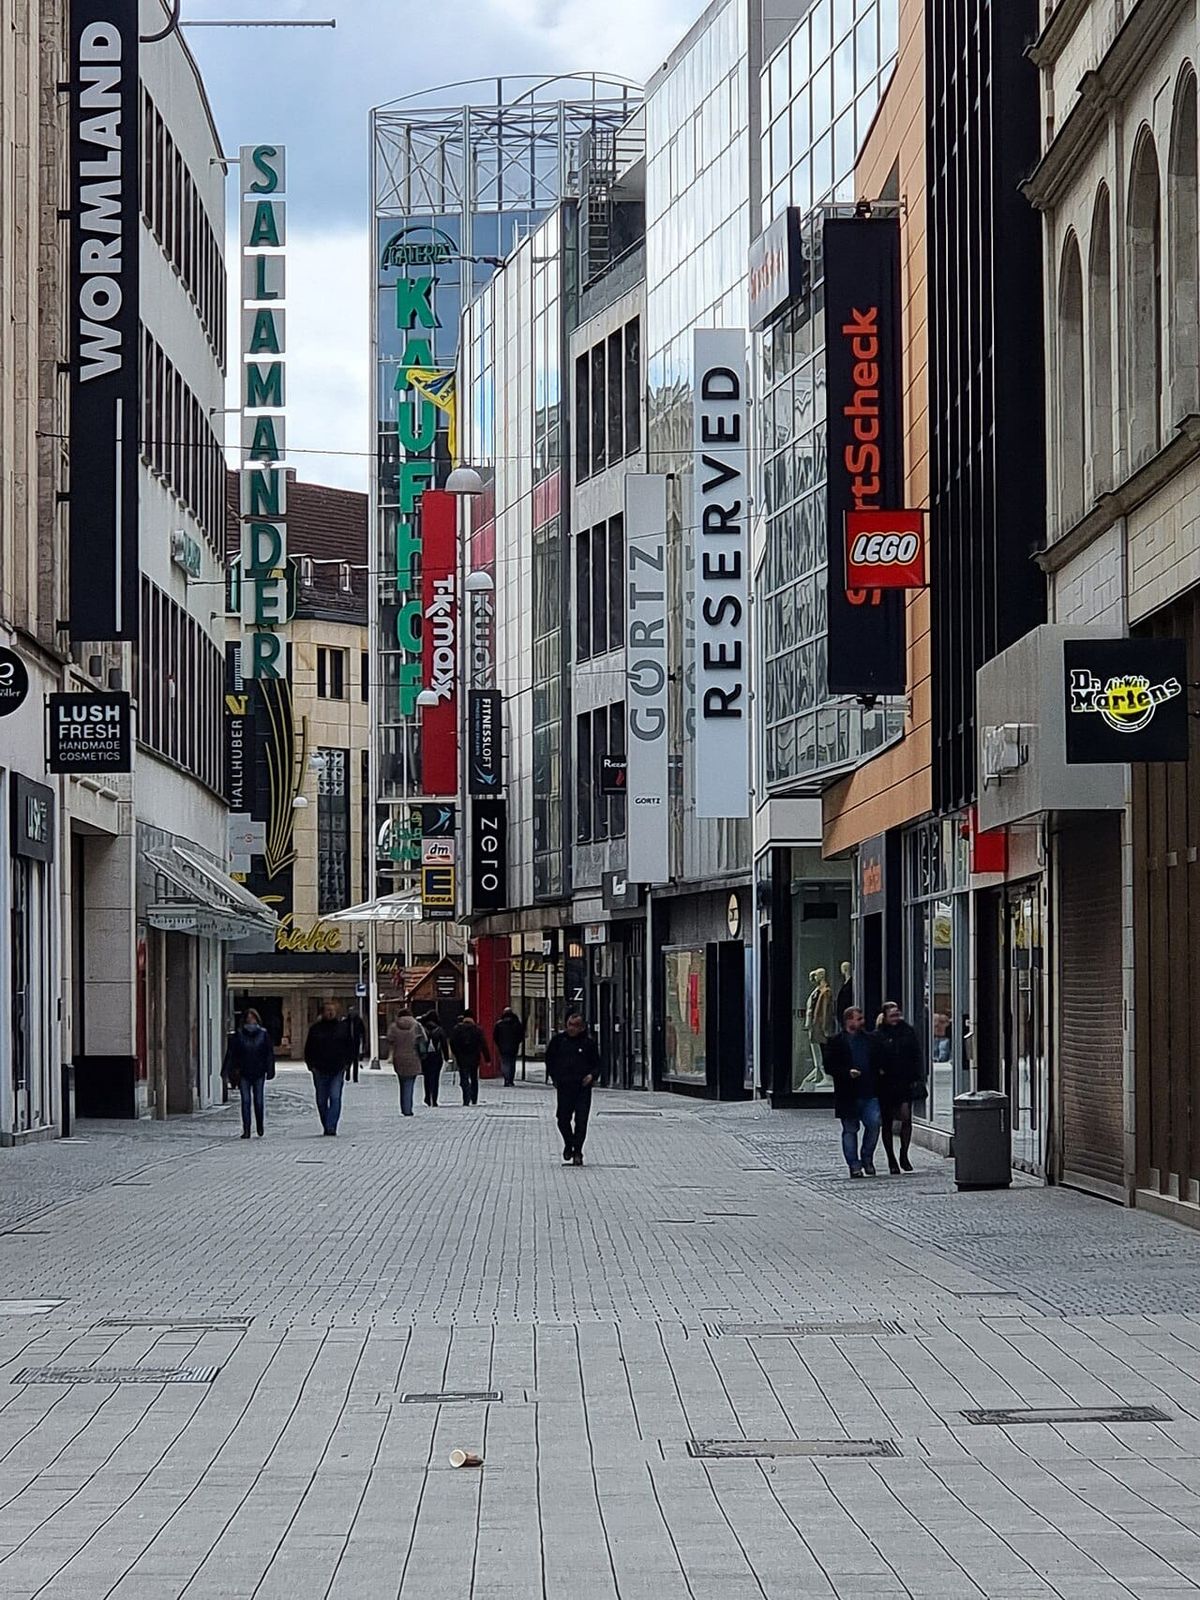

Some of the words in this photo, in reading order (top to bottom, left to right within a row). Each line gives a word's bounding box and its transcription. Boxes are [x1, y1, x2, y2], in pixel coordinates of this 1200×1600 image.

[79, 20, 122, 382] WORMLAND
[247, 145, 283, 679] SALAMANDER
[702, 366, 742, 719] RESERVED
[851, 532, 920, 566] LEGO
[630, 545, 666, 741] GÖRTZ
[1071, 669, 1101, 691] Dr.
[1071, 678, 1182, 712] Martens
[59, 705, 120, 722] LUSH
[59, 724, 120, 739] FRESH
[59, 741, 120, 750] HANDMADE
[482, 698, 492, 768] FITNESSLOFT
[59, 752, 120, 761] COSMETICS
[231, 719, 243, 808] HALLHUBER
[430, 844, 449, 855] dm
